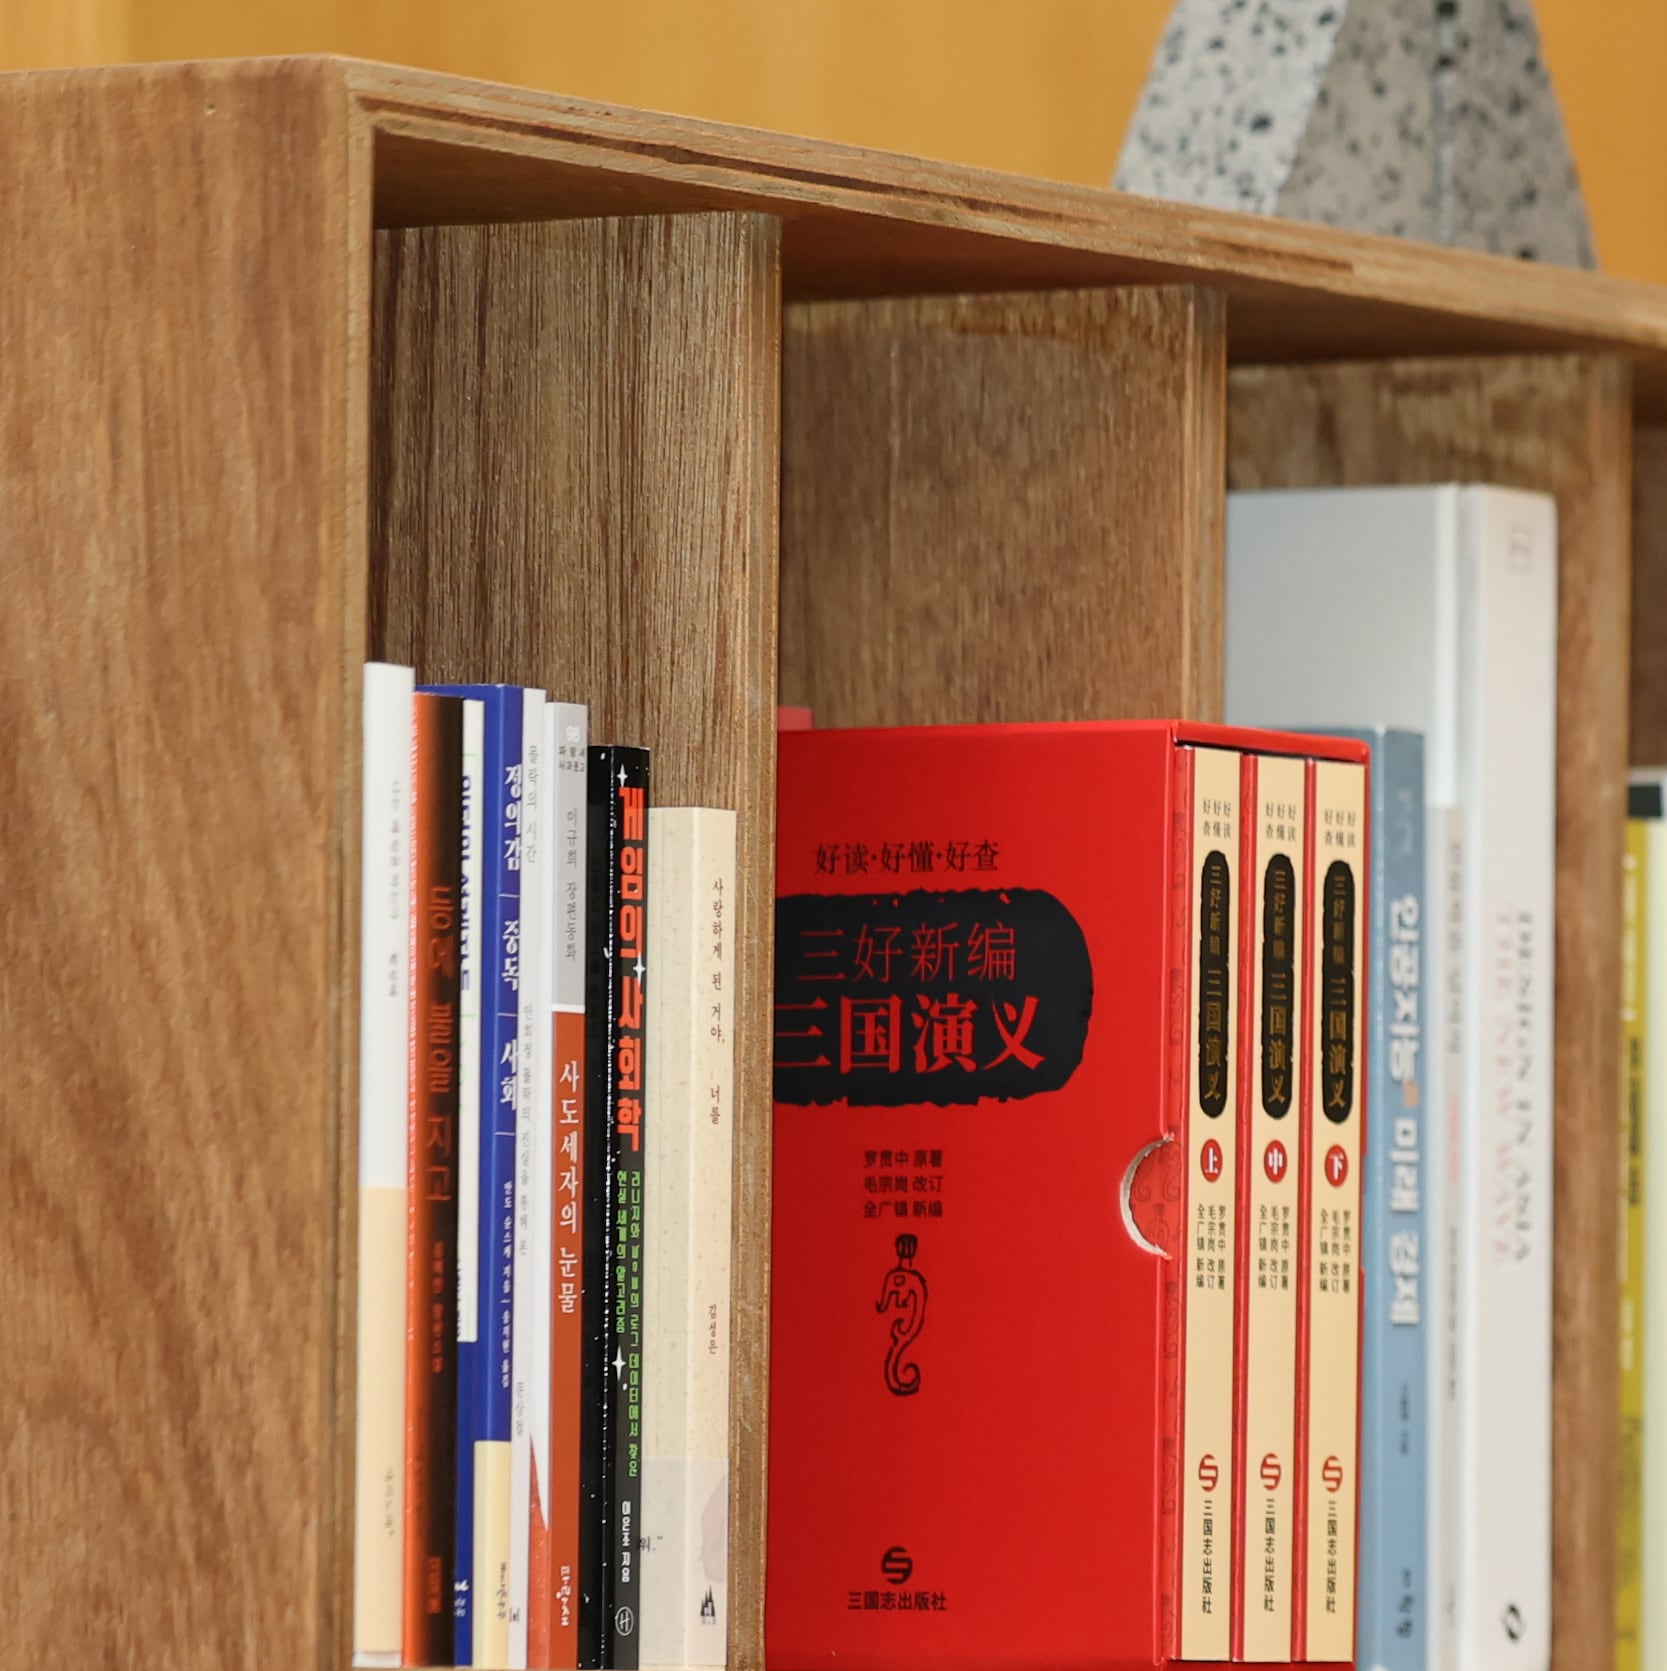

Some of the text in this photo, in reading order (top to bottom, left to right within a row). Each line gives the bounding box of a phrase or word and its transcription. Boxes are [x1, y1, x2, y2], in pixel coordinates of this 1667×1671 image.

[501, 764, 522, 1110] 정의감 중독 사회
[616, 787, 645, 1152] 게임의 사회학
[774, 992, 1046, 1075] 三国演义
[796, 921, 1018, 983] 三好新编
[557, 1060, 580, 1314] 사도세자의 눈물
